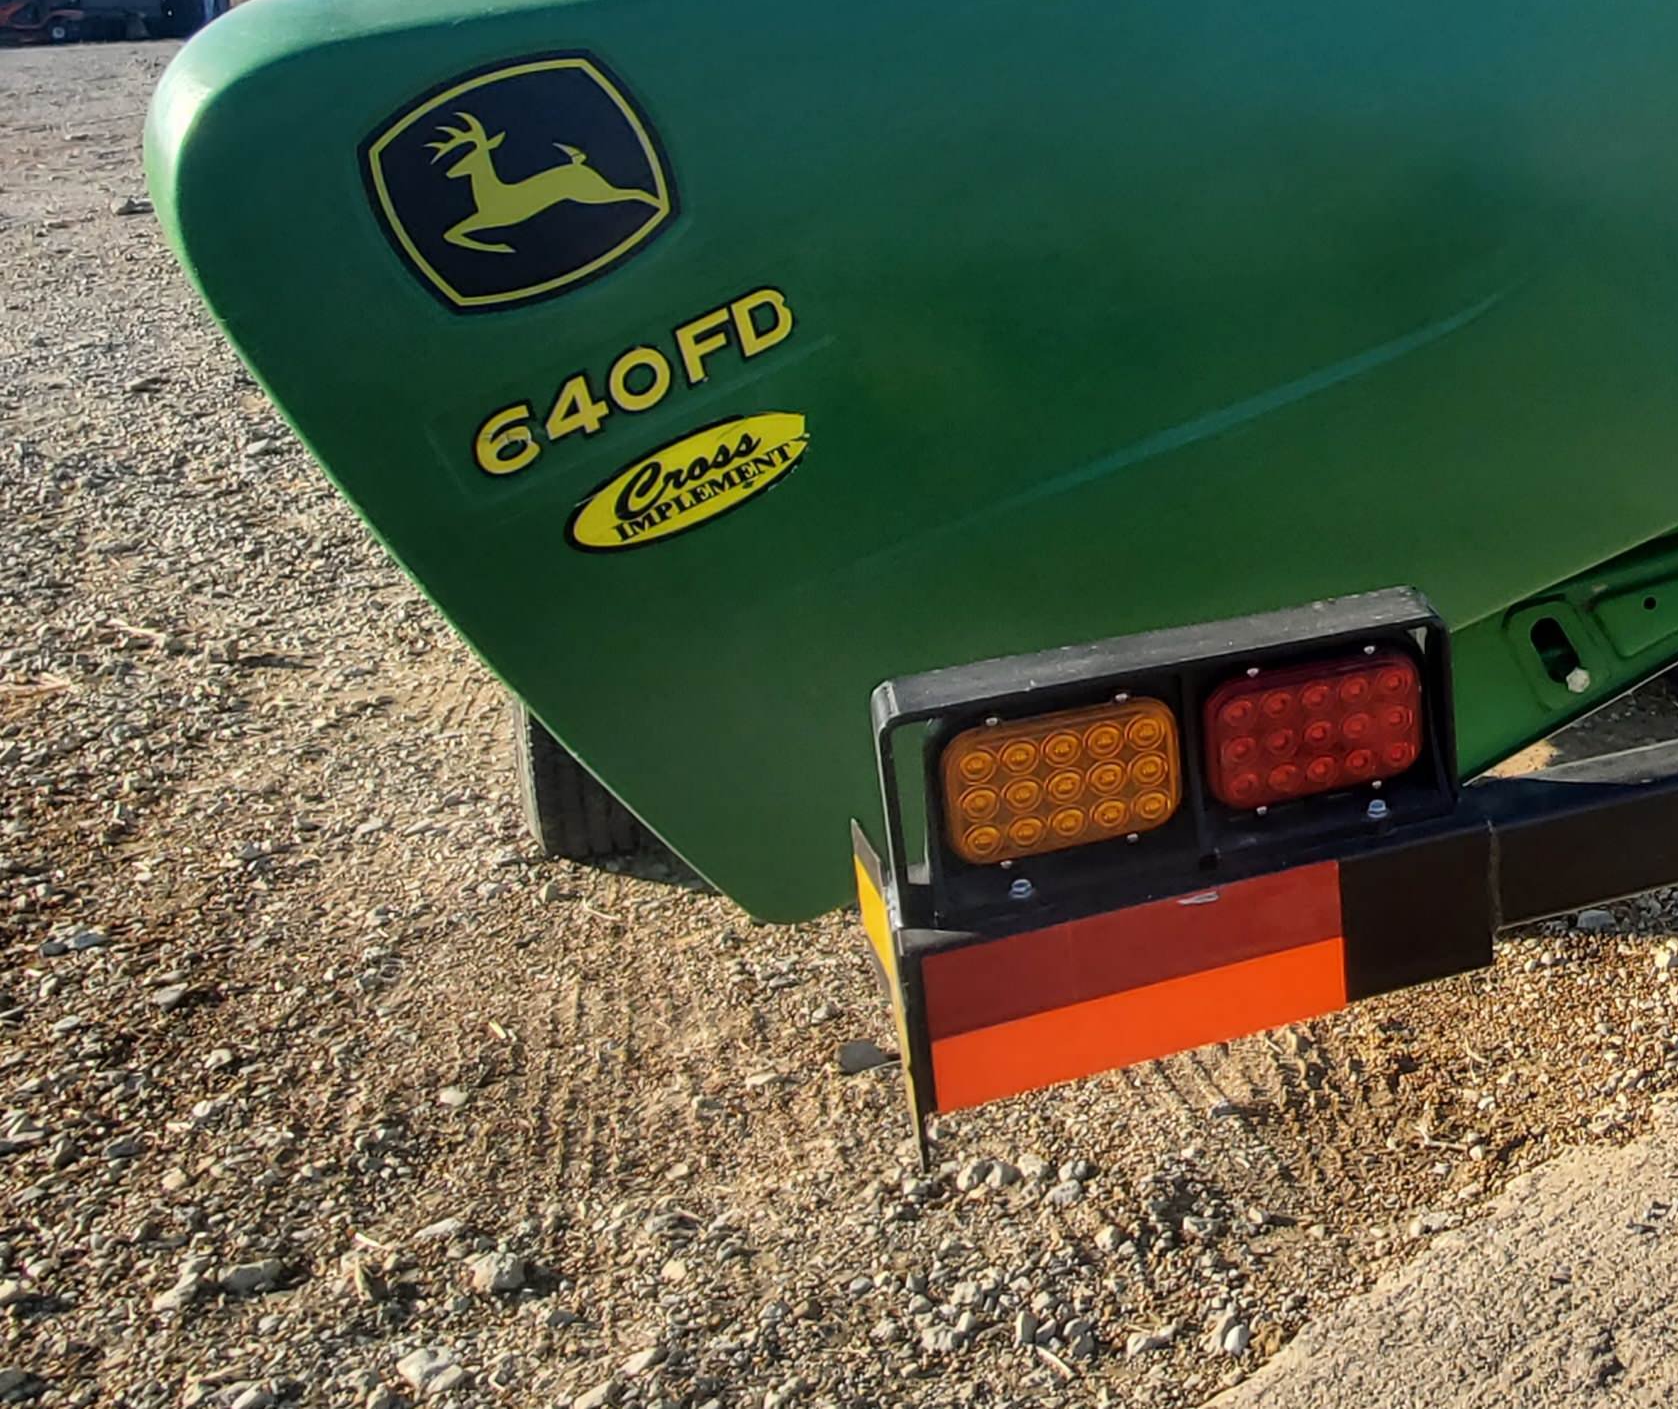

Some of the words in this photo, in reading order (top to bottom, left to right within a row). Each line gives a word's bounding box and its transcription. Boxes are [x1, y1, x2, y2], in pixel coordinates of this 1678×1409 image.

[474, 287, 795, 476] 640FD
[613, 443, 793, 541] IMPLEMENT
[615, 433, 761, 520] Cross
